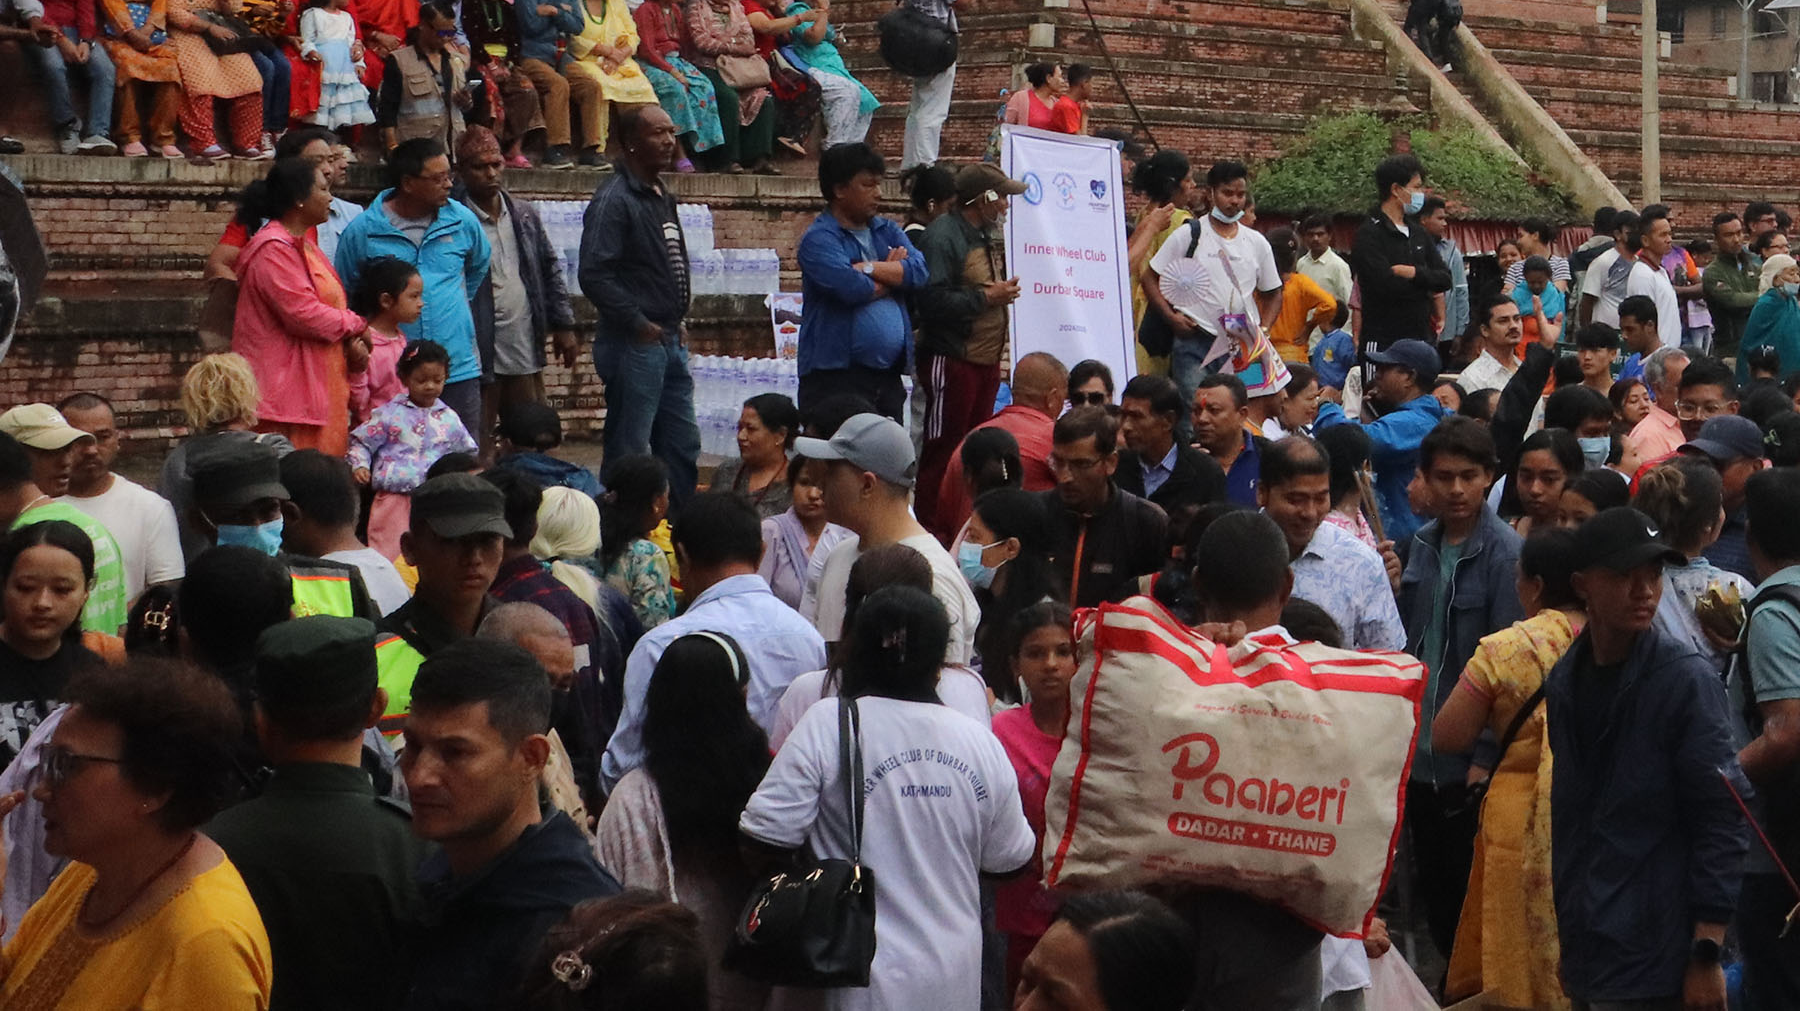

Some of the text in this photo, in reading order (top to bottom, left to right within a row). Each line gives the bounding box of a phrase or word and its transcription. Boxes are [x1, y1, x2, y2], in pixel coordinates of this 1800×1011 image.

[1024, 242, 1107, 262] Inner Wheel Club
[1065, 266, 1073, 277] of
[1033, 282, 1105, 301] Durbar Square
[872, 754, 902, 780] WHEEL
[900, 748, 923, 764] CLUB
[925, 748, 936, 762] OF
[937, 751, 969, 777] DURBAR
[967, 770, 989, 802] SQUARE
[1161, 731, 1351, 826] Paaneri
[900, 784, 952, 799] KATHMANDU
[1175, 817, 1332, 852] DADAR THANE
